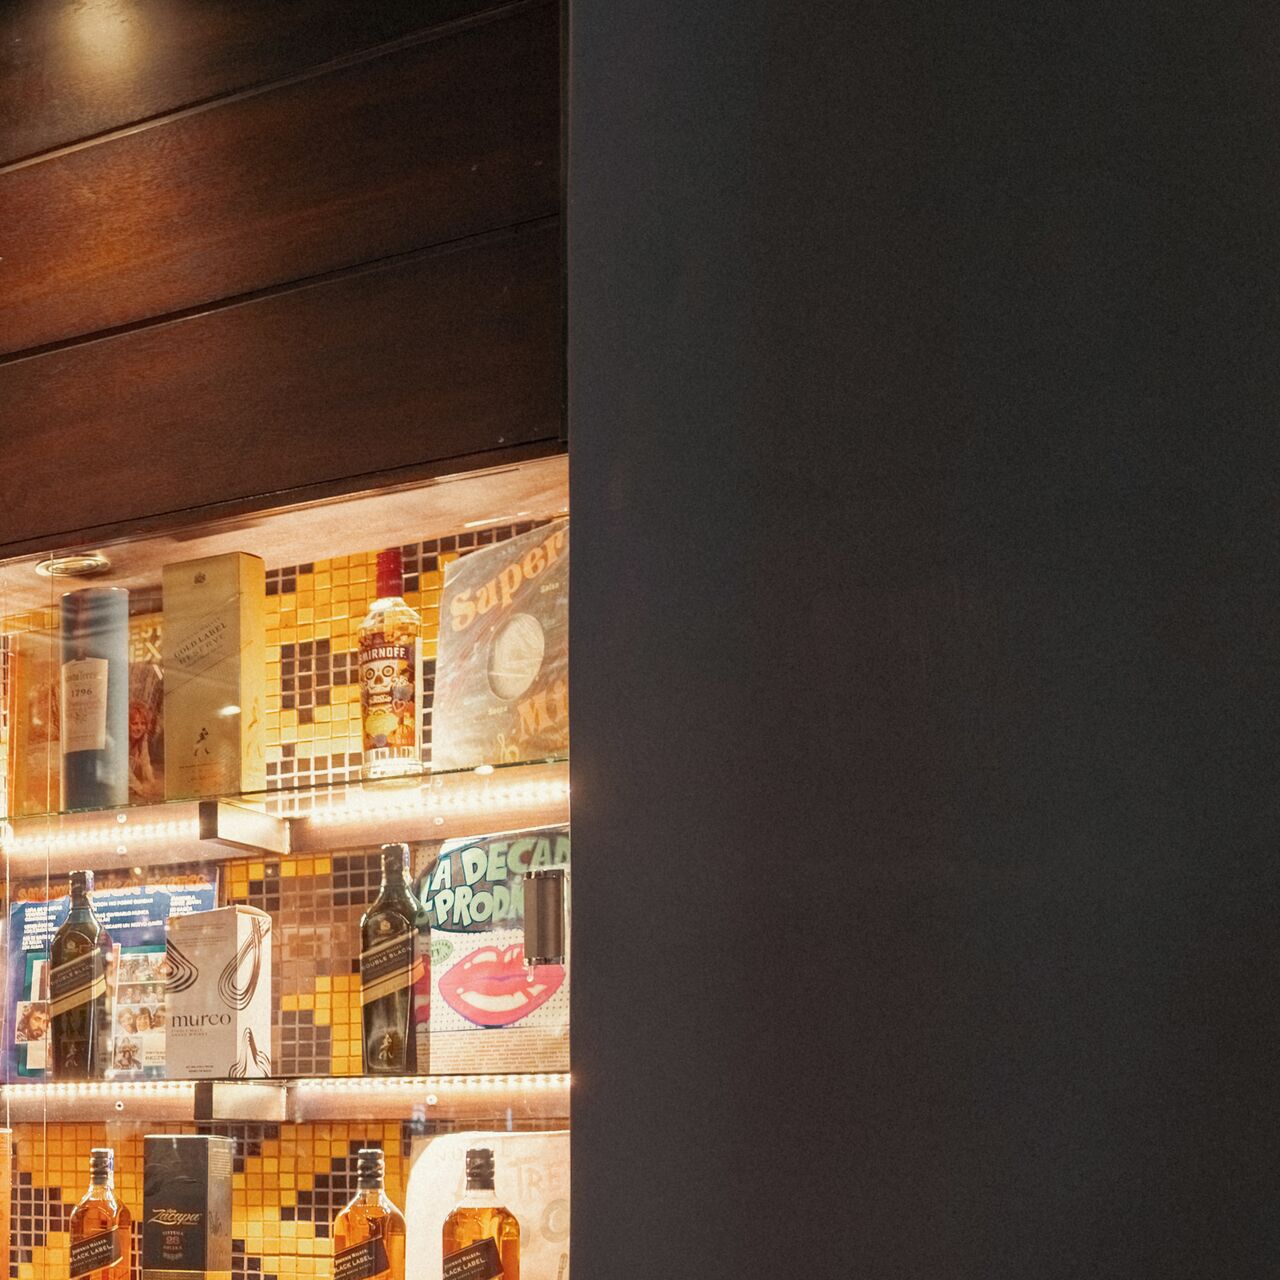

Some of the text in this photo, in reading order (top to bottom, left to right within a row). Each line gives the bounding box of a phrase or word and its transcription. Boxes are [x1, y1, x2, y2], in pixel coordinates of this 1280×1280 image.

[450, 529, 567, 632] Super
[359, 646, 406, 662] SMIRNOFF
[71, 688, 93, 697] 1796
[171, 1012, 231, 1028] murco
[147, 1208, 201, 1225] Zacapa
[463, 1257, 486, 1270] LABEL
